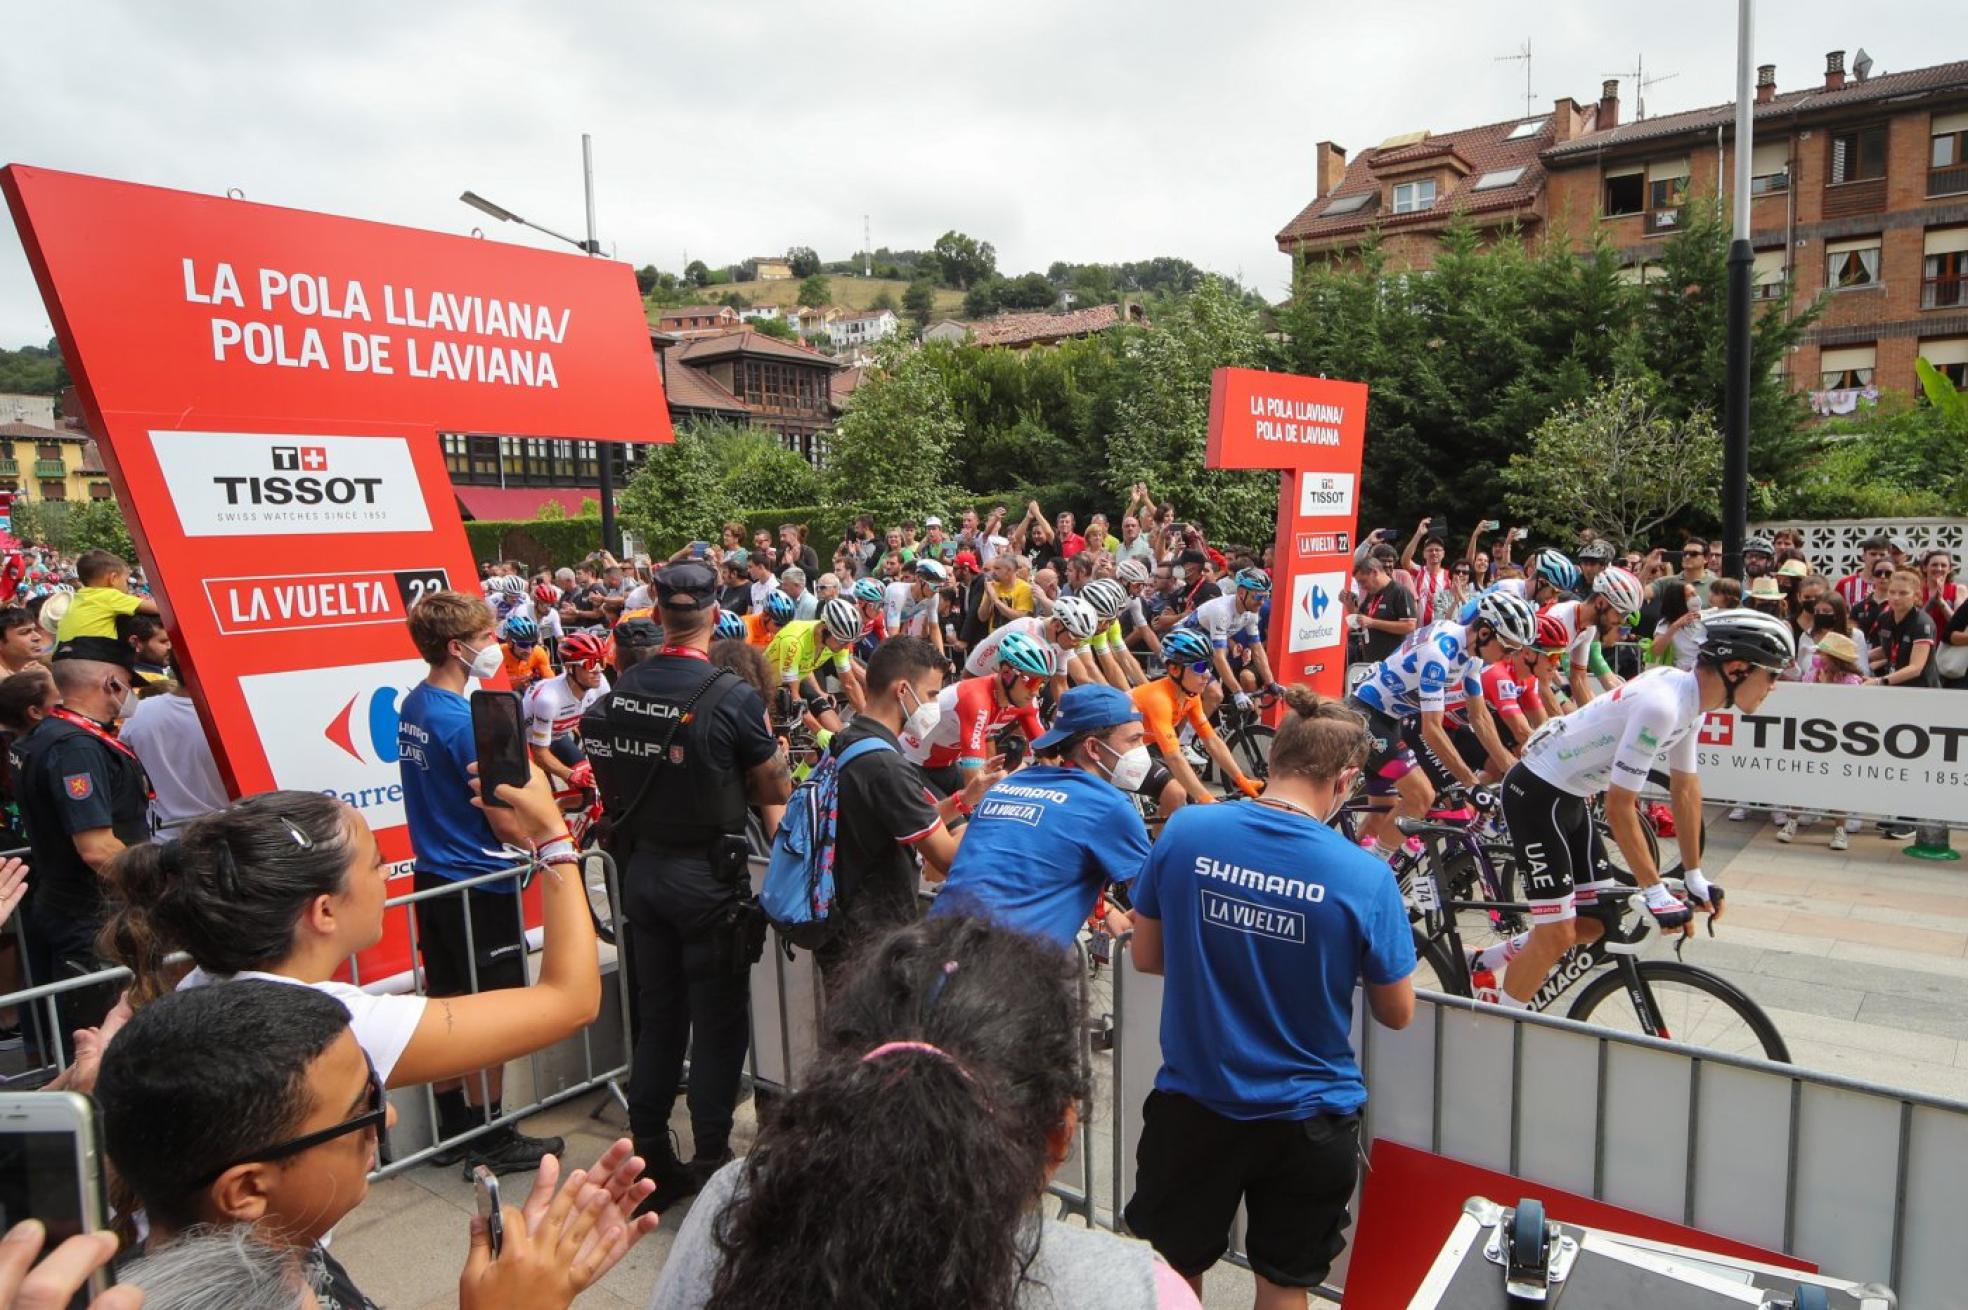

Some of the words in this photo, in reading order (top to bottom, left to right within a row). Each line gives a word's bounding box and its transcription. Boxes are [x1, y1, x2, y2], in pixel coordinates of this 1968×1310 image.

[182, 257, 245, 308] LA
[259, 268, 372, 322] POLA
[384, 284, 571, 344] LLAVIANA/
[211, 318, 330, 370] POLA
[342, 331, 394, 375] DE
[407, 338, 560, 389] LAVIANA
[1250, 395, 1264, 416] LA
[1267, 397, 1293, 419] POLA
[1295, 401, 1344, 425] LLAVIANA/
[1256, 420, 1282, 441] POLA
[1285, 423, 1297, 443] DE
[1300, 424, 1340, 446] LAVIANA
[213, 476, 383, 505] TISSOT
[1310, 491, 1344, 504] TISSOT
[217, 511, 257, 522] SWISS
[264, 511, 319, 521] WATCHES
[324, 511, 358, 521] SINCE
[364, 510, 387, 520] 1853
[1301, 537, 1311, 552] LA
[1311, 536, 1335, 551] VUELTA
[229, 586, 272, 623] LA
[273, 580, 391, 620] VUELTA
[1299, 625, 1333, 641] Carrefour
[612, 695, 682, 720] POLICIA
[615, 736, 667, 761] U.I.P.
[1741, 714, 1968, 762] TISSOT
[1731, 755, 1830, 775] WATCHES
[1843, 763, 1909, 782] SINCE
[1924, 771, 1968, 786] 1853
[991, 783, 1068, 805] SHIMANO
[983, 802, 999, 816] LA
[997, 804, 1036, 820] VUELTA
[1194, 856, 1326, 903] SHIMANO
[1525, 842, 1555, 889] UAE
[1414, 880, 1432, 903] 174
[1210, 898, 1230, 921] LA
[1233, 904, 1296, 937] VUELTA
[1529, 951, 1595, 1011] LNAGO
